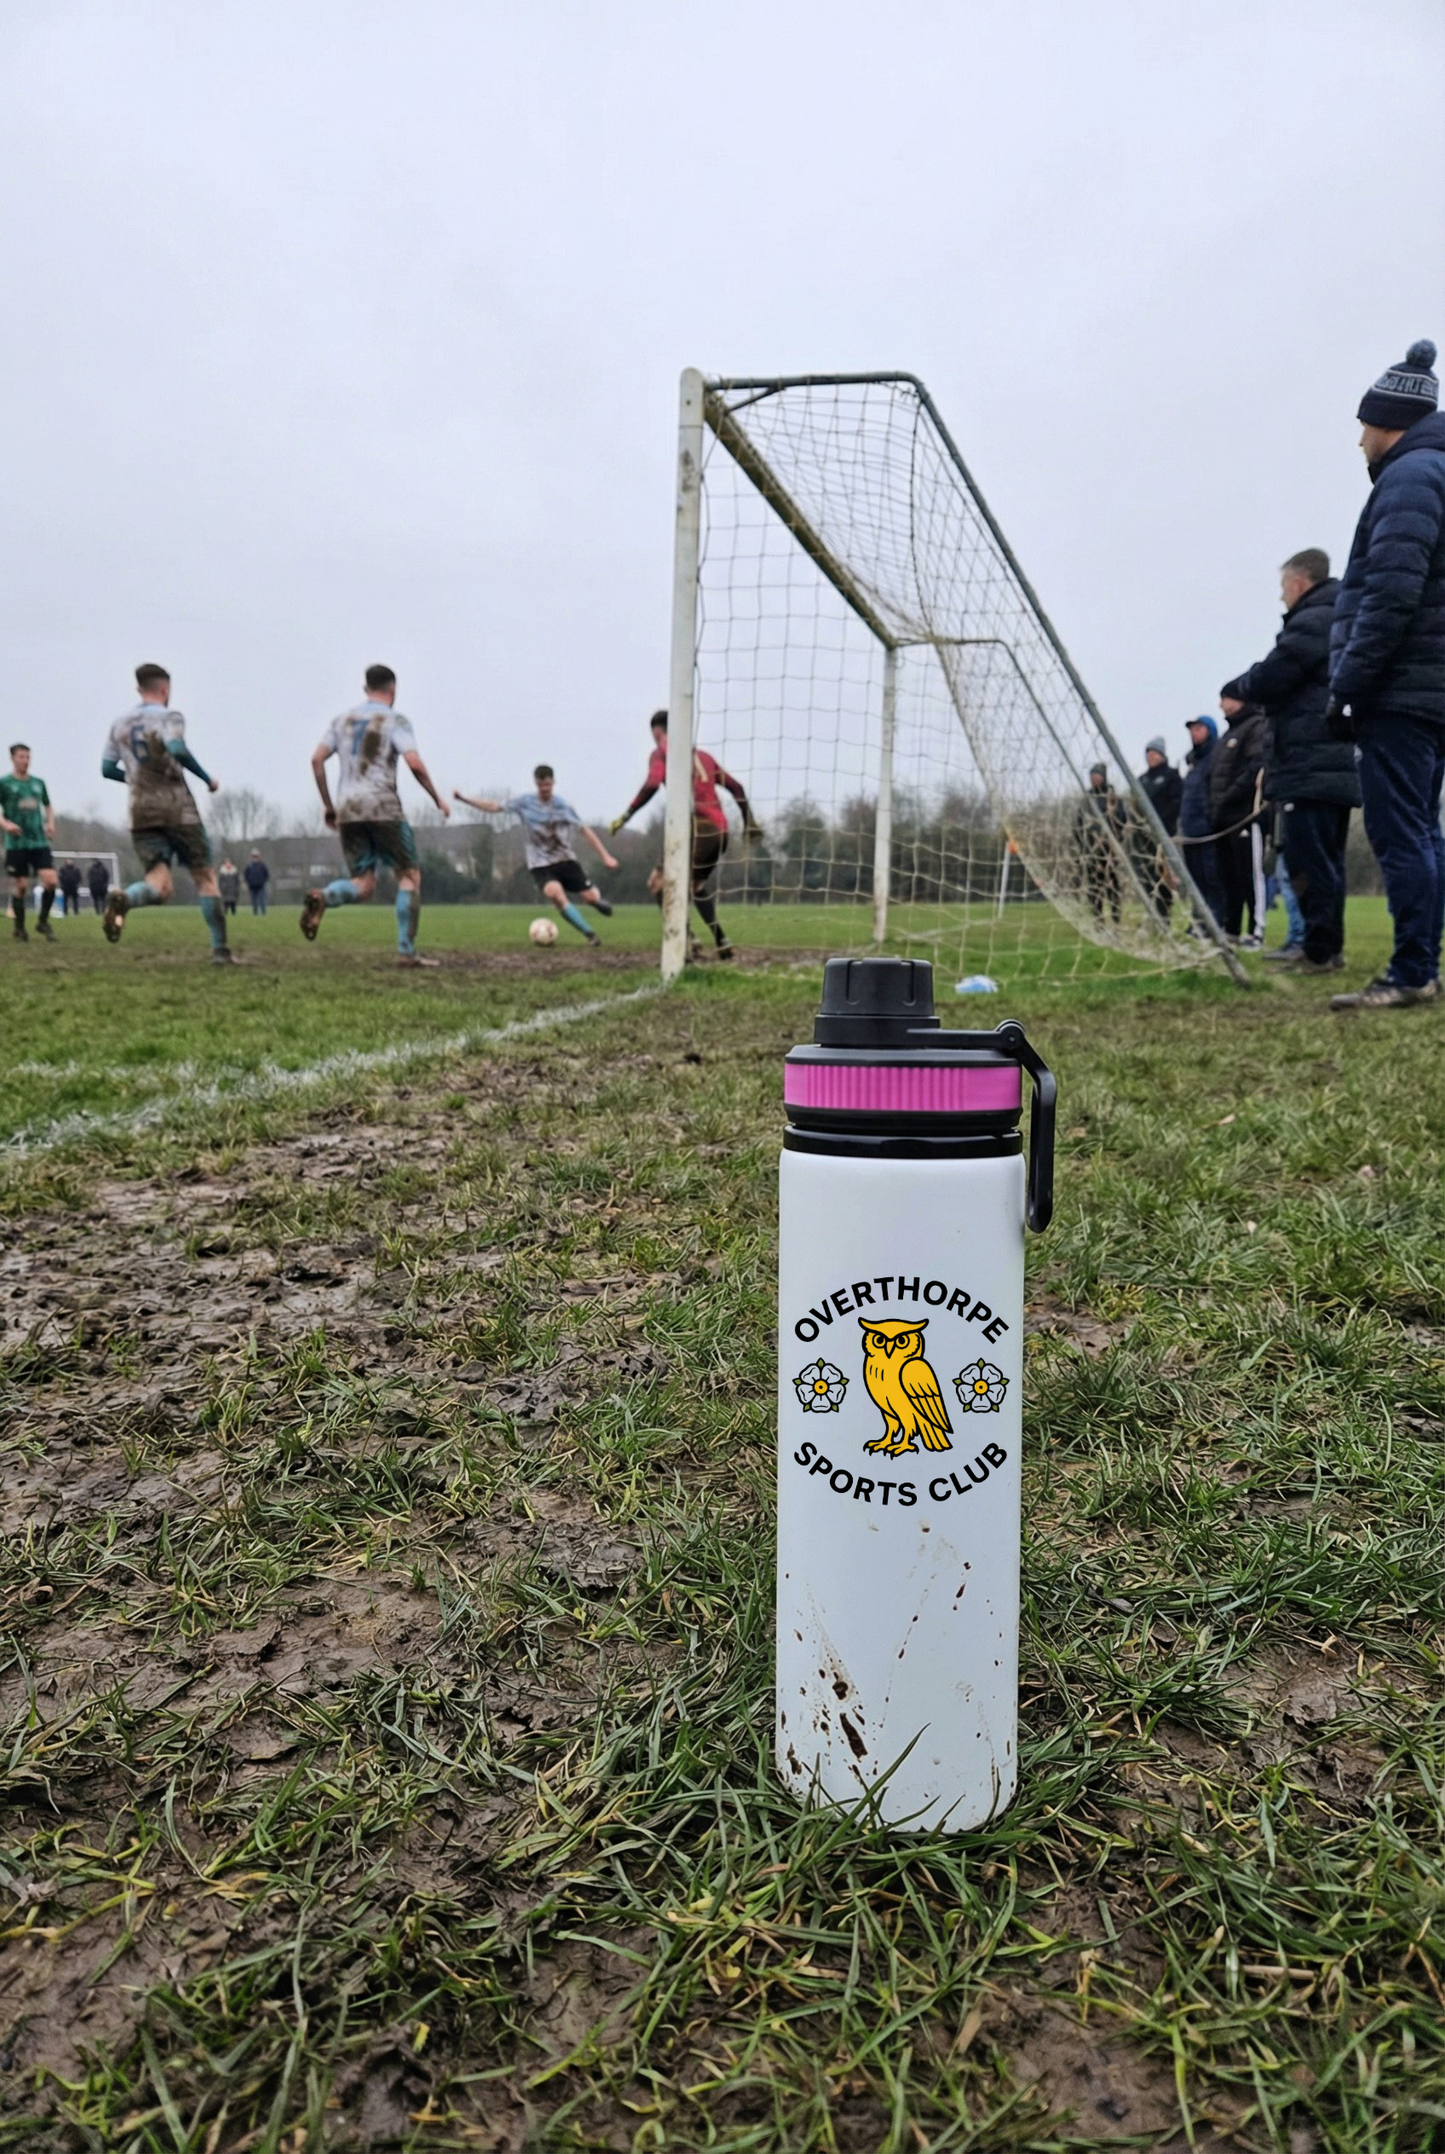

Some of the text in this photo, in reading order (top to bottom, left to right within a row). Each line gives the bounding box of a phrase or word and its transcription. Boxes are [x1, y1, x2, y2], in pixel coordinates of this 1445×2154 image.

[130, 725, 150, 764] 6
[794, 1275, 1010, 1345] OVERTHORPE
[793, 1442, 1009, 1507] SPORTS CLUB
